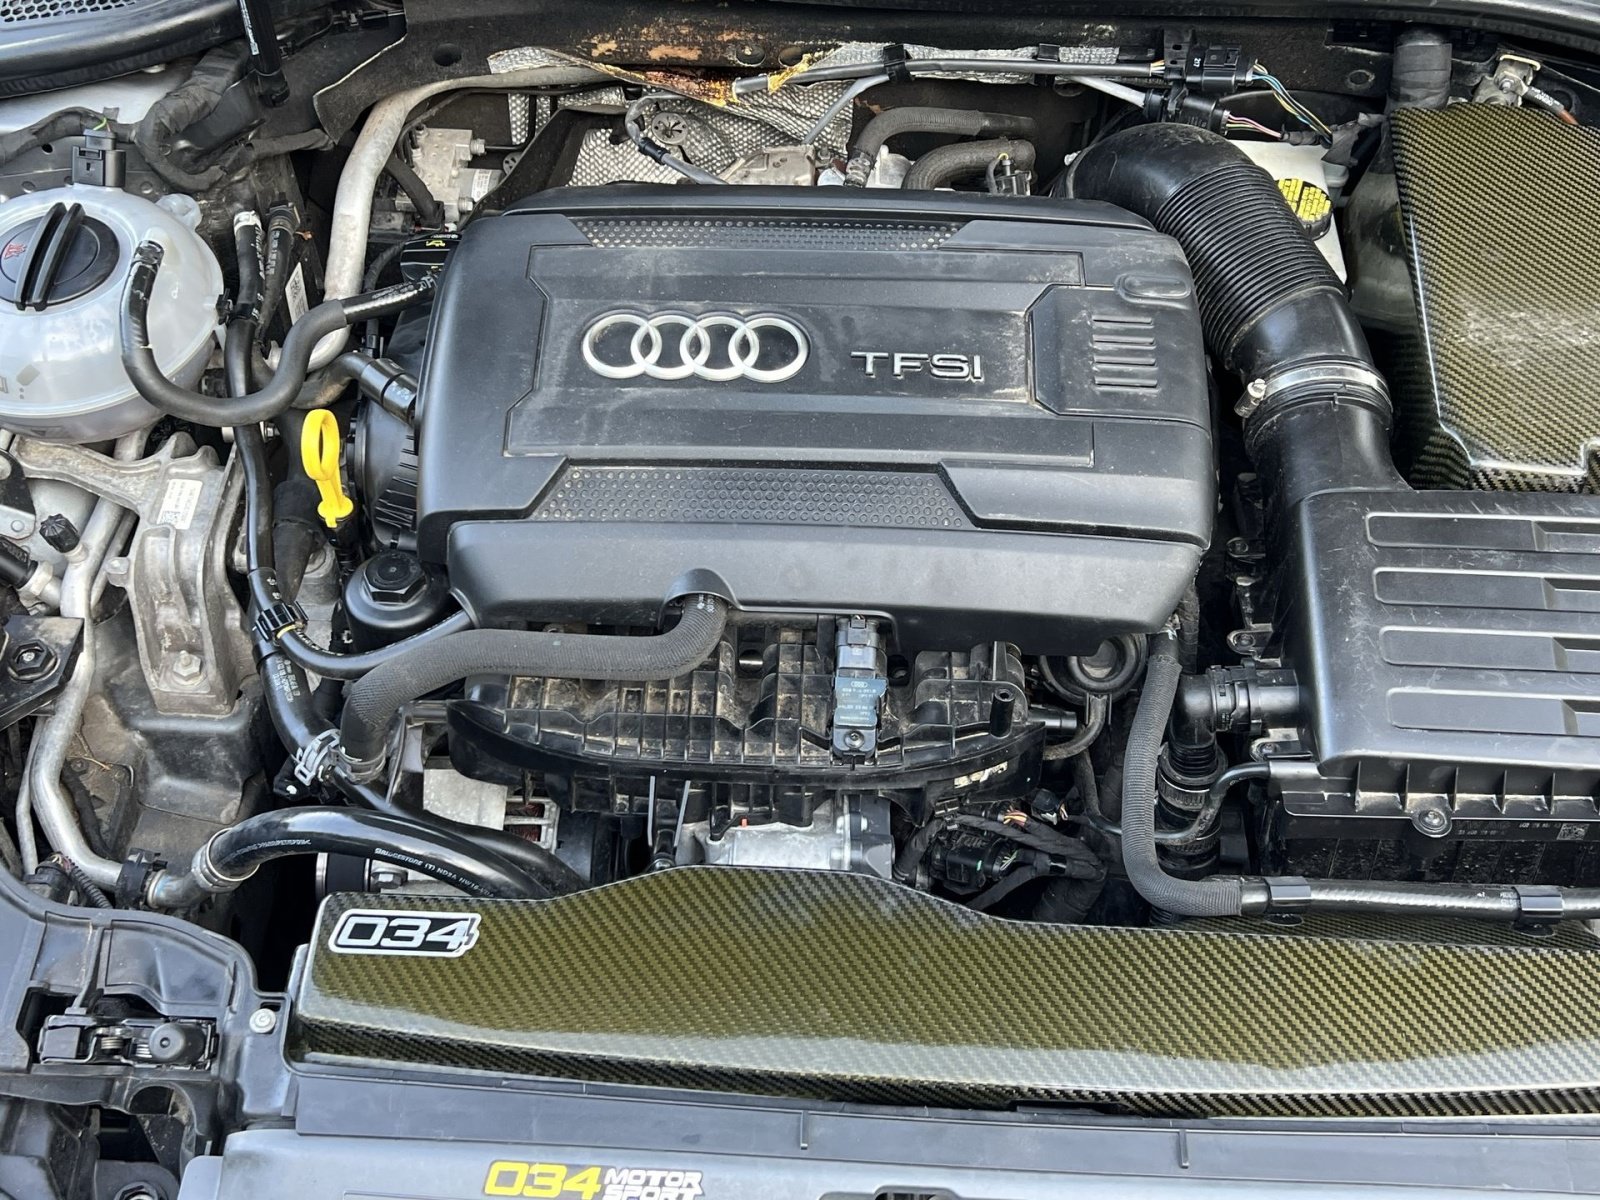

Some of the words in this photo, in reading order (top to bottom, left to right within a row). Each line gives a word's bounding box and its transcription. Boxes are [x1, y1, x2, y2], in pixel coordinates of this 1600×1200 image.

[850, 351, 983, 380] TFSI
[374, 847, 424, 866] BRIDGESTONE
[337, 916, 469, 950] 034
[484, 1161, 601, 1200] 034
[604, 1168, 702, 1189] MOTOR
